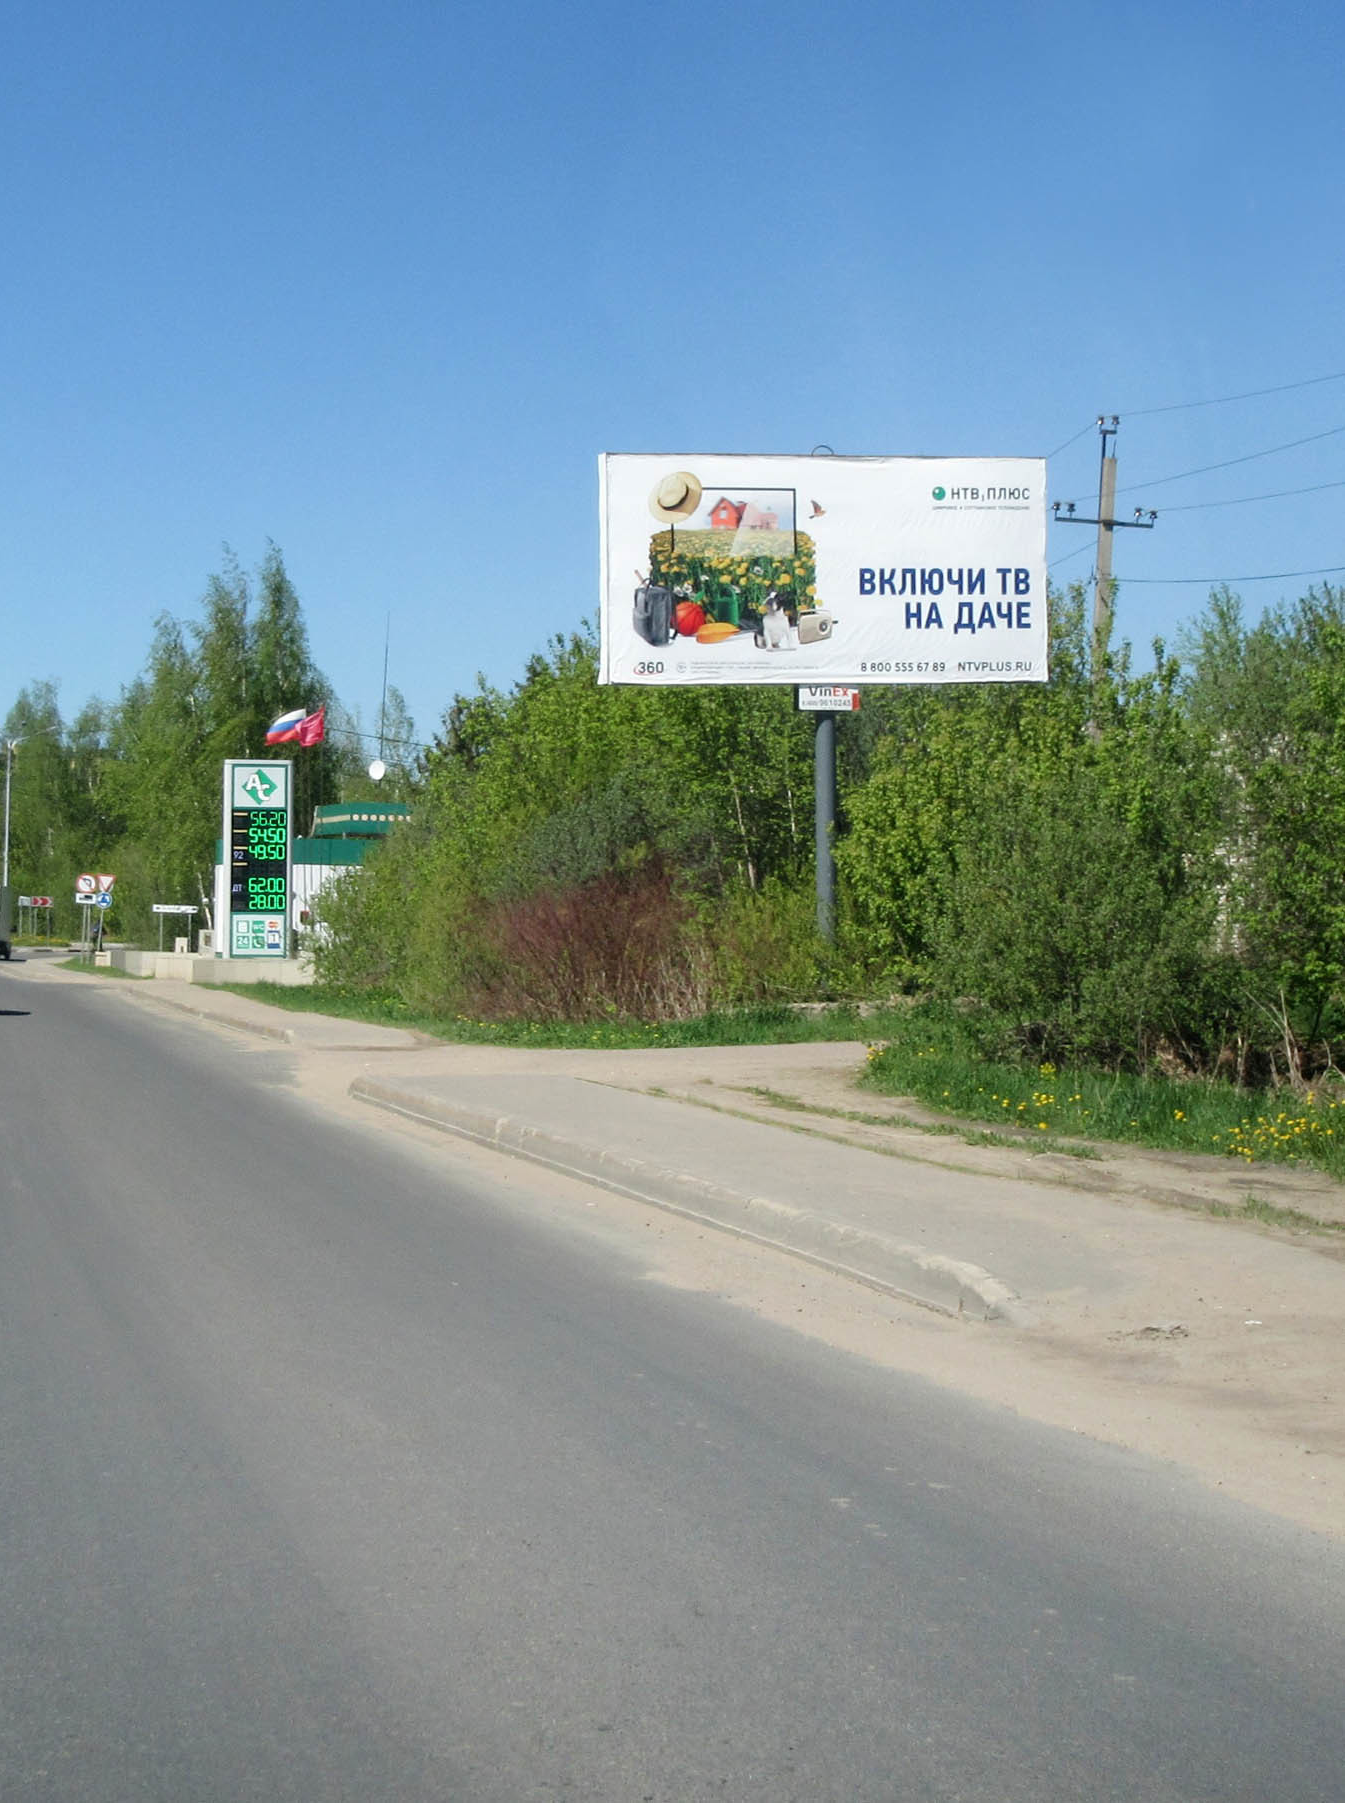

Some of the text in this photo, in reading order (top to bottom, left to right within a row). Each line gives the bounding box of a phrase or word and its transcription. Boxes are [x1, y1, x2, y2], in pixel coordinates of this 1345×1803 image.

[859, 567, 1031, 596] ВКЛЮЧИ ТВ
[905, 601, 1032, 634] НА ДАЧЕ
[638, 661, 665, 674] 360
[860, 662, 946, 672] 8 800 555 67 89
[957, 661, 1032, 672] NTVPLUS.RU
[233, 851, 244, 860] 92
